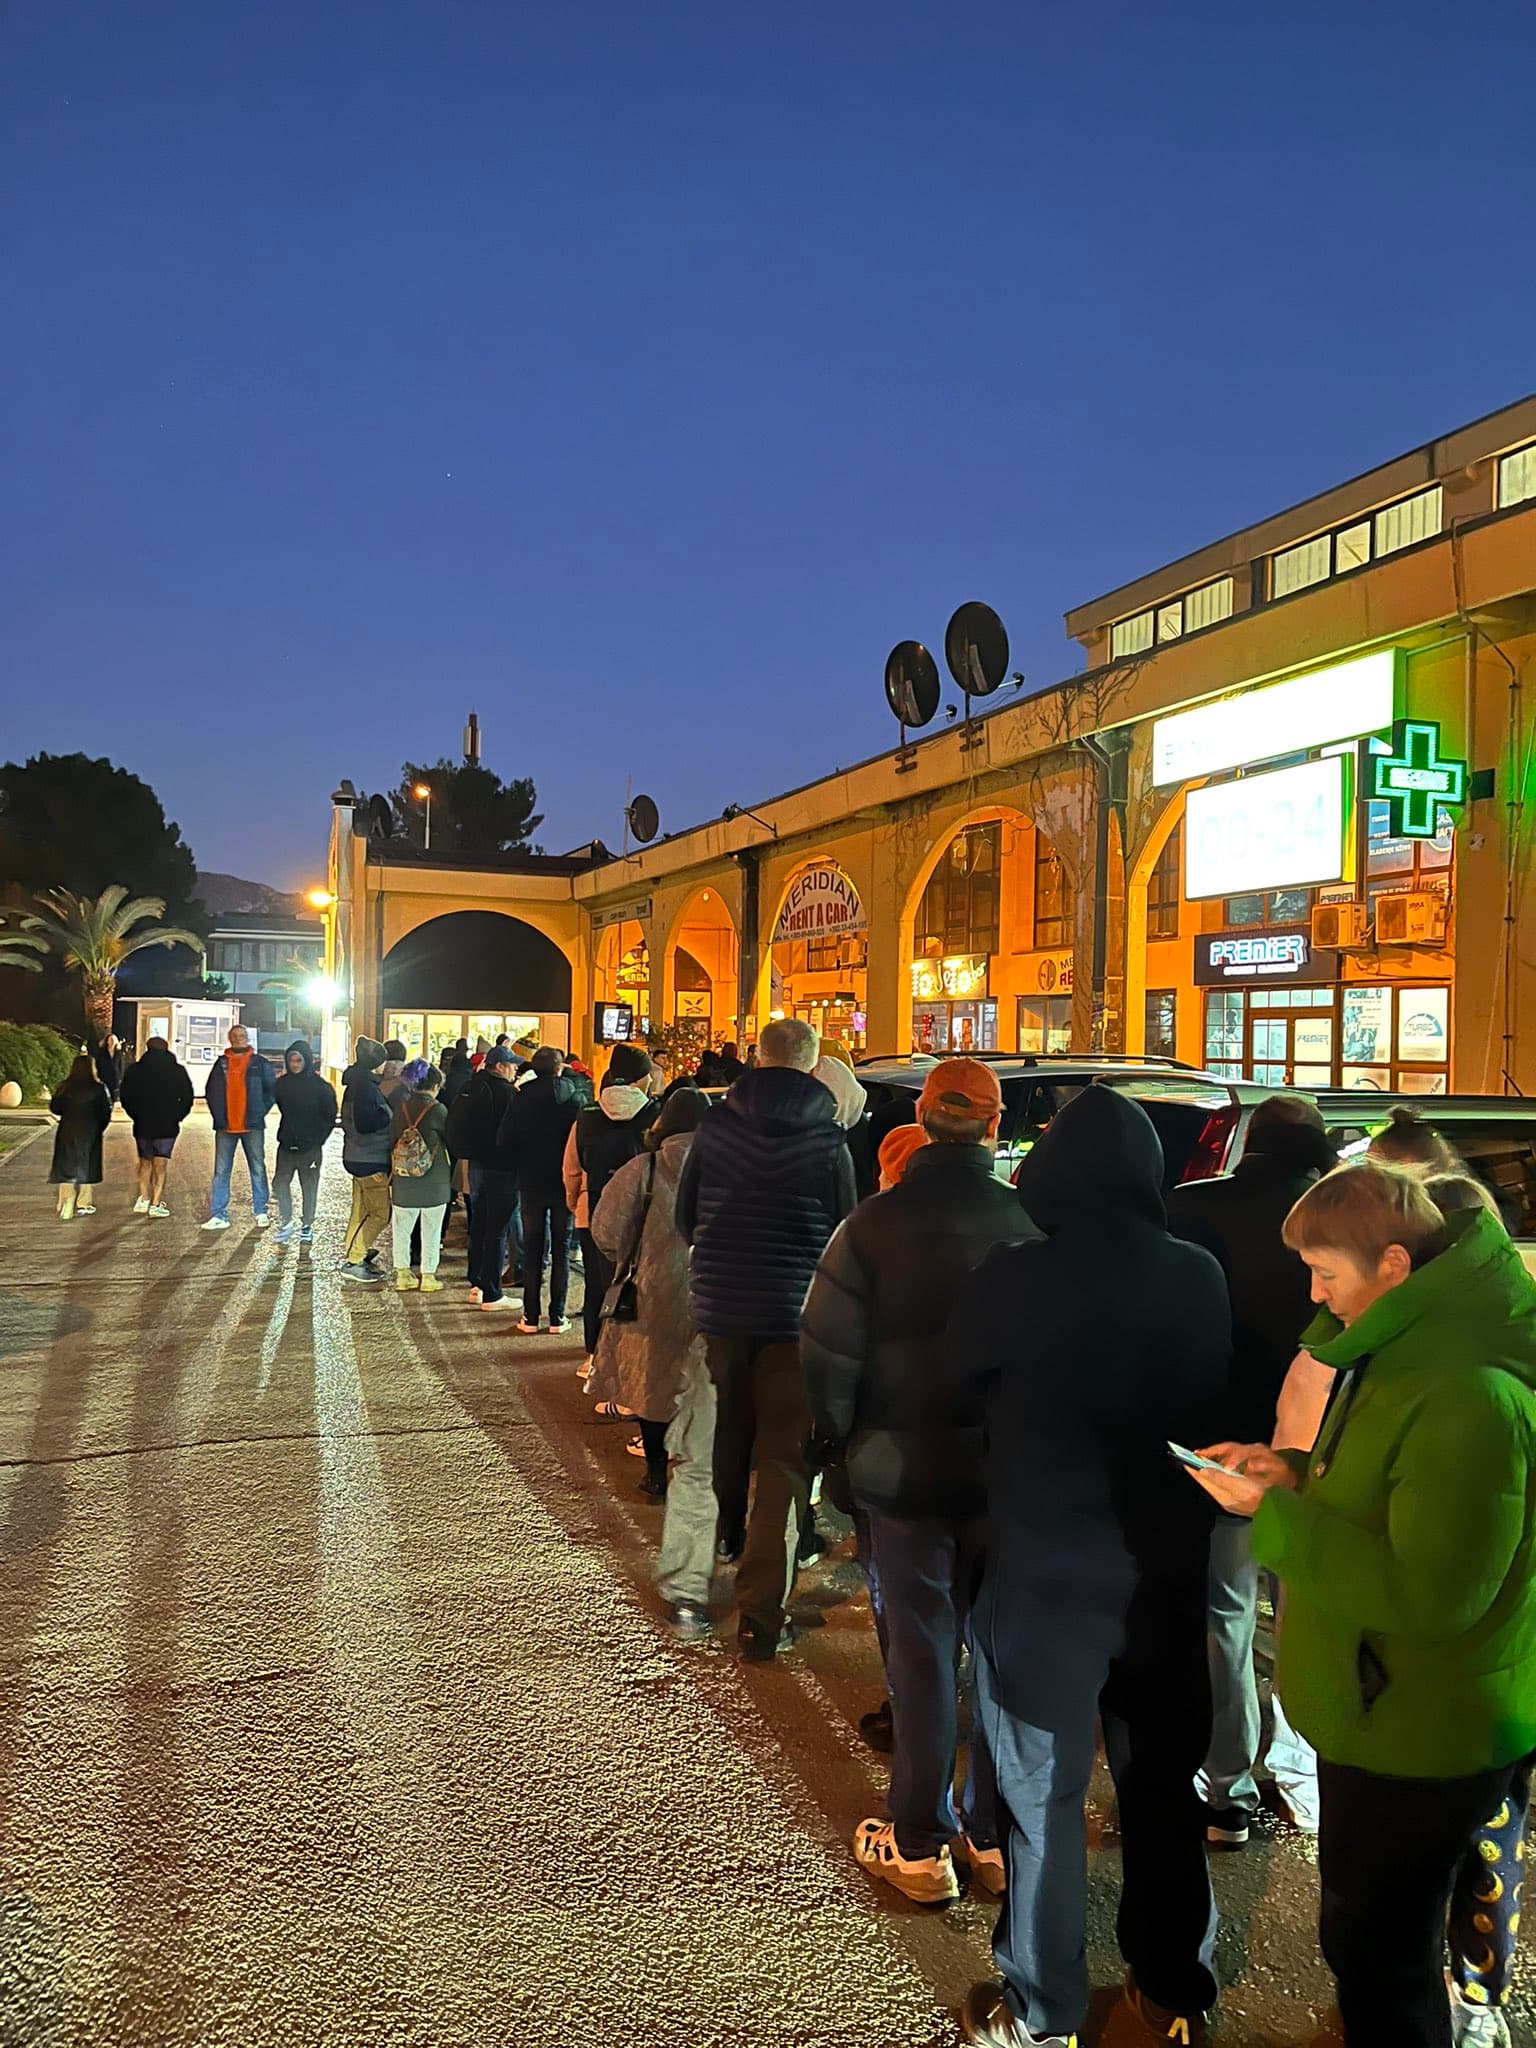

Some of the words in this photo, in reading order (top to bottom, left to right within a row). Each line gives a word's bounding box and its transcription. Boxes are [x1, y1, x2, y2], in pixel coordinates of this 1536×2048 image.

[779, 871, 859, 930] MERIDIAN
[789, 905, 815, 931] RENT
[816, 903, 824, 926] A
[826, 902, 848, 925] CAR
[1060, 957, 1073, 969] ME
[1210, 935, 1307, 966] PREMIER
[1060, 970, 1073, 985] RE
